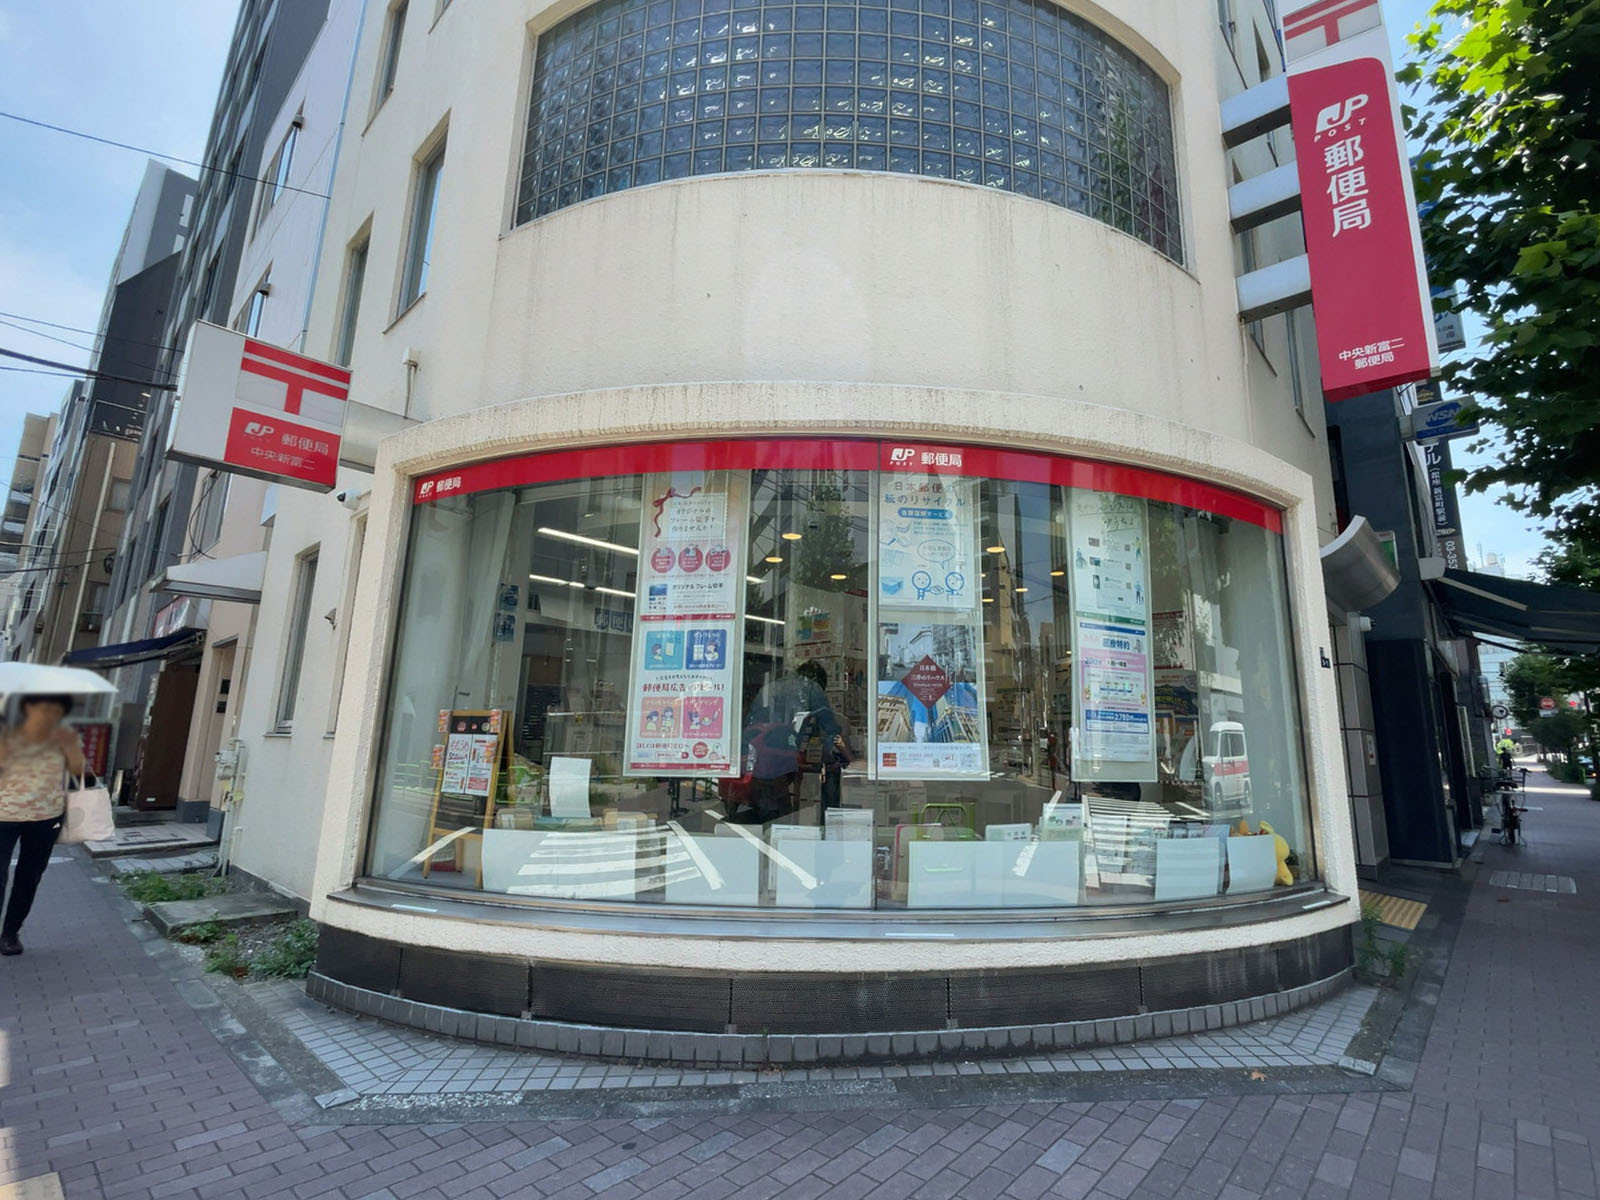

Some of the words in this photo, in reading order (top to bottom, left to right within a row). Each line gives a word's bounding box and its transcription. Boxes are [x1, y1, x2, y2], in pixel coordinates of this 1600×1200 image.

[1314, 117, 1366, 143] POST
[1324, 135, 1373, 238] 郵便局
[1338, 337, 1405, 361] 中央新富二
[1354, 351, 1395, 370] 郵便局
[281, 433, 329, 455] 郵便局
[250, 447, 316, 470] 中央新富二
[921, 452, 963, 467] 郵便局
[436, 476, 462, 493] 郵便局
